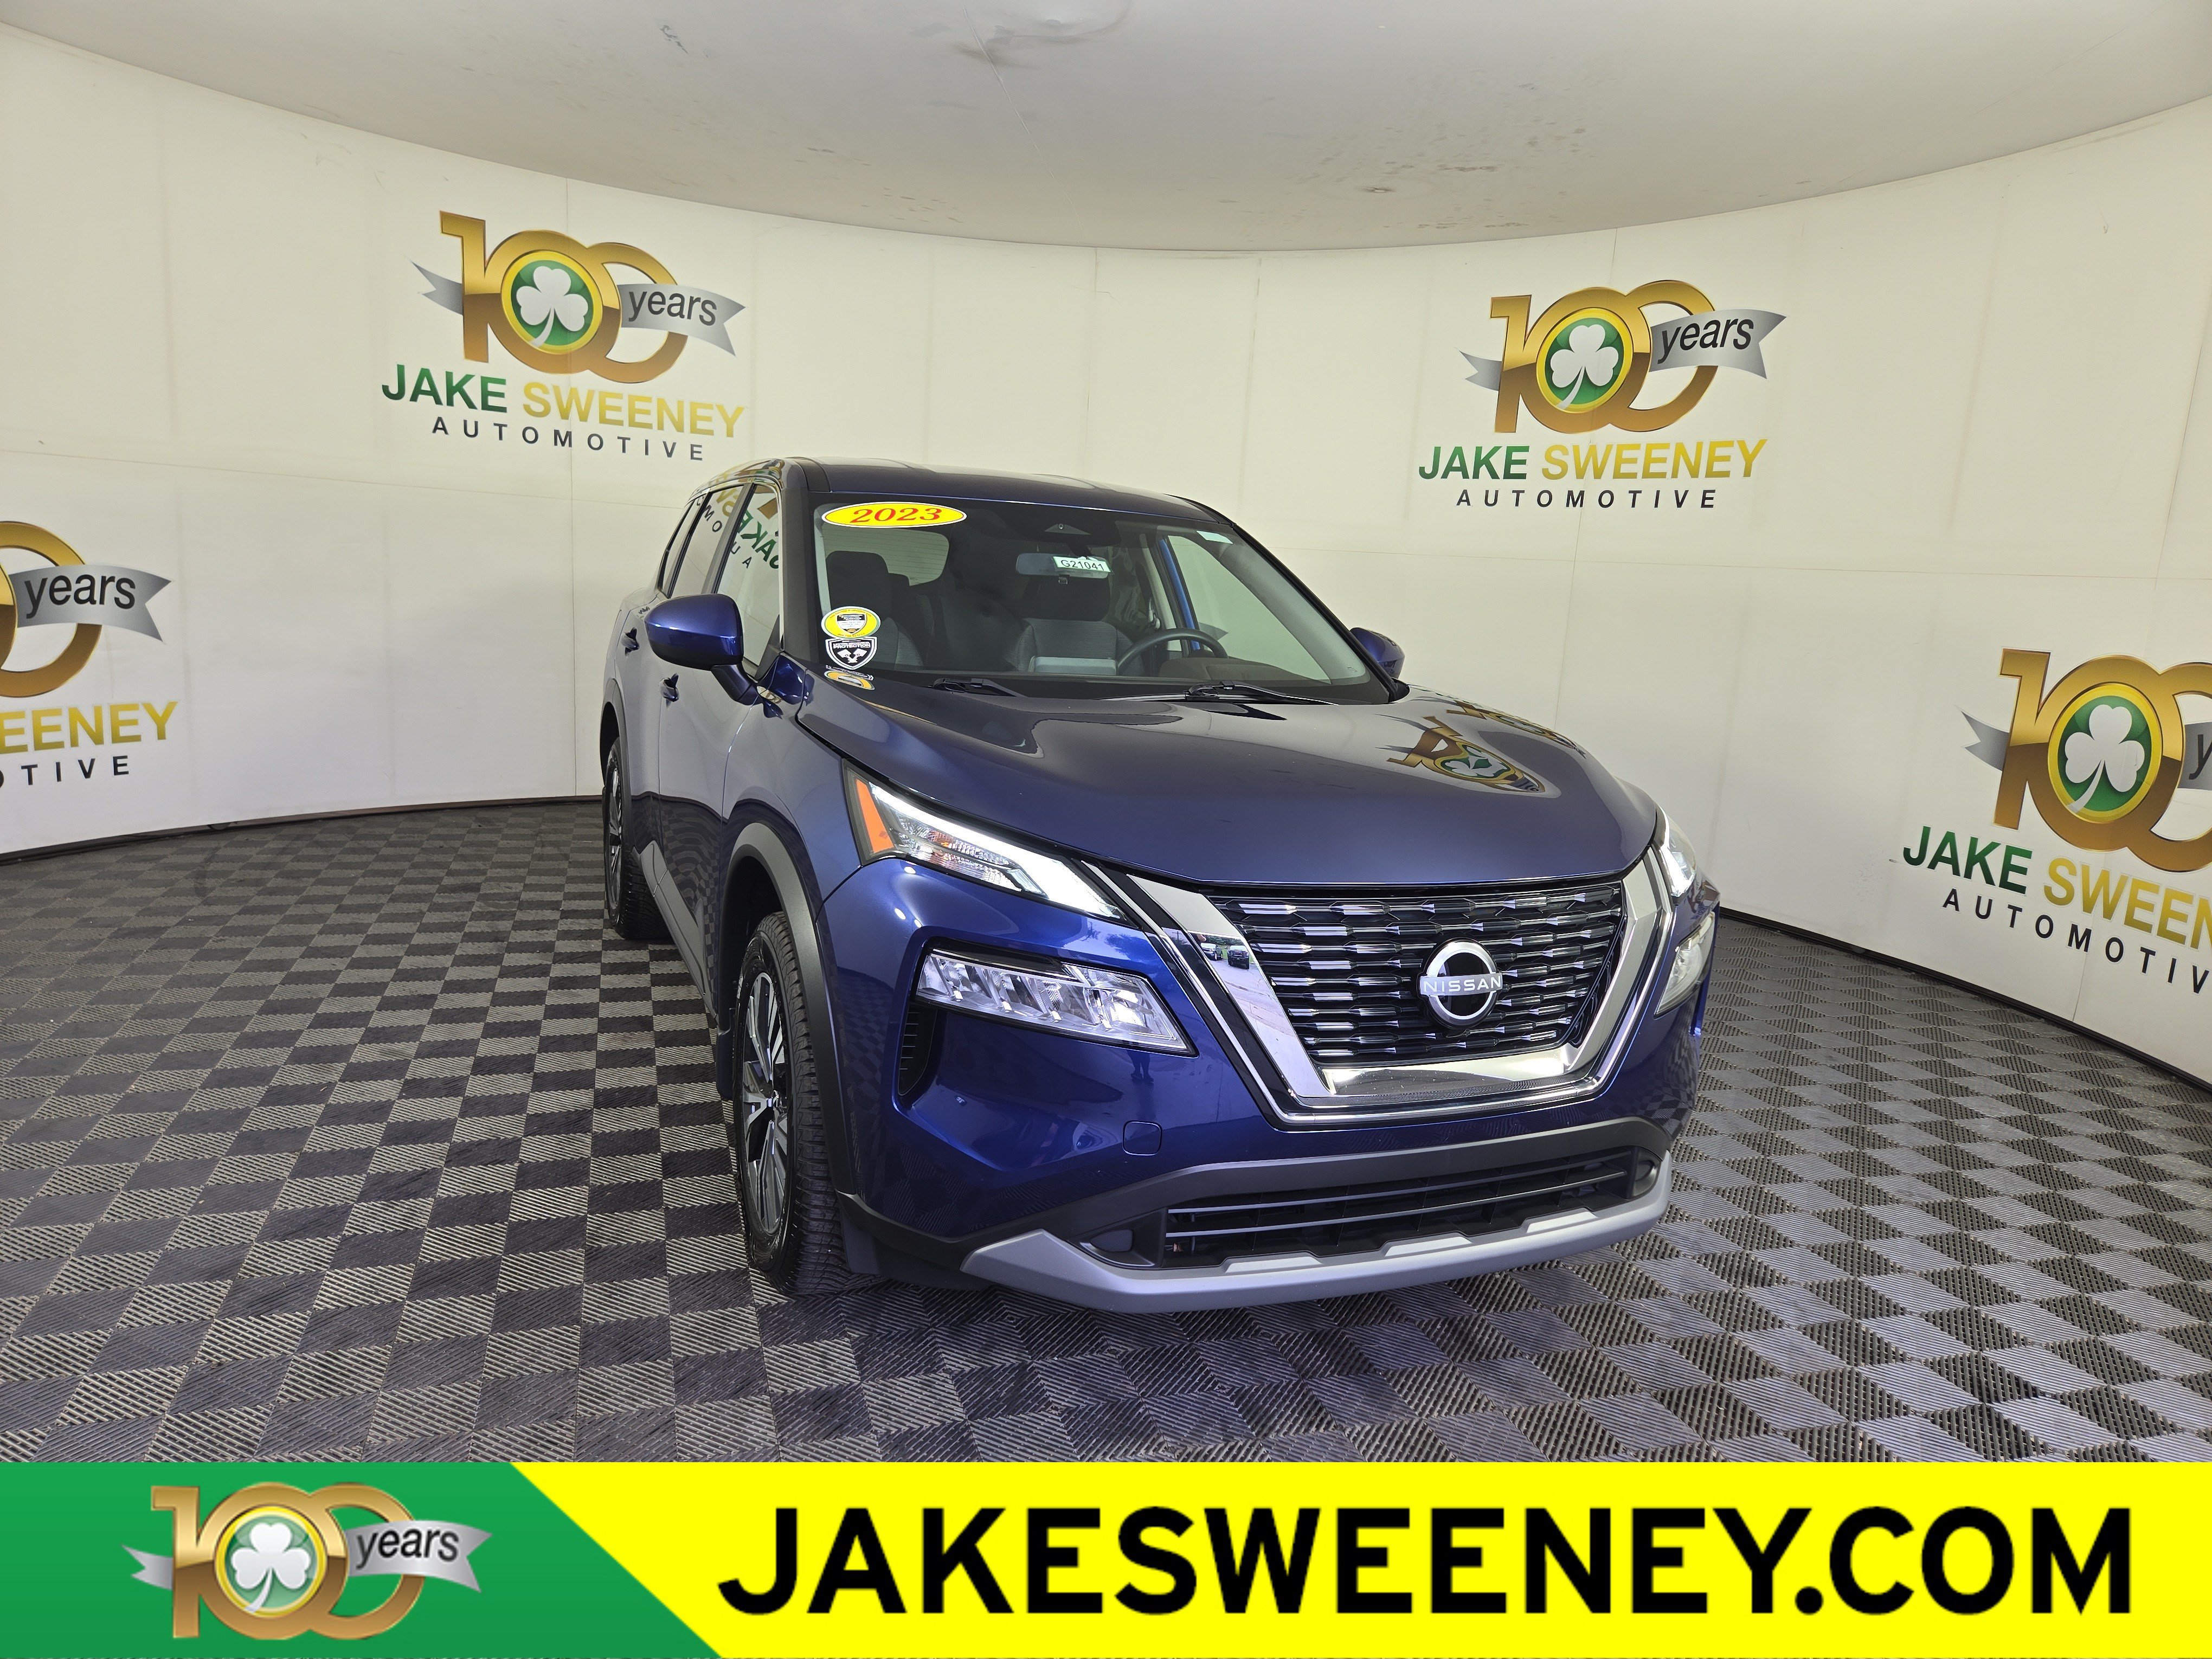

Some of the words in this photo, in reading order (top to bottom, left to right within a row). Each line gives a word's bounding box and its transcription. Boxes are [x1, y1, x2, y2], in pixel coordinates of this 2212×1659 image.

[628, 289, 717, 326] years
[1657, 316, 1754, 364] years
[382, 364, 507, 413] JAKE
[523, 381, 745, 438] SWEENEY
[432, 416, 703, 461] AUTOMOTIVE
[1418, 445, 1529, 480] JAKE
[1541, 439, 1767, 479] SWEENEY
[850, 507, 942, 523] 2023
[1456, 488, 1716, 509] AUTOMOTIVE
[1061, 560, 1104, 571] G21041
[24, 573, 136, 619] years
[0, 755, 129, 789] TIVE
[1903, 826, 2033, 895] JAKE
[1943, 889, 2210, 994] AUTOMOTIV
[1423, 975, 1501, 993] NISSAN
